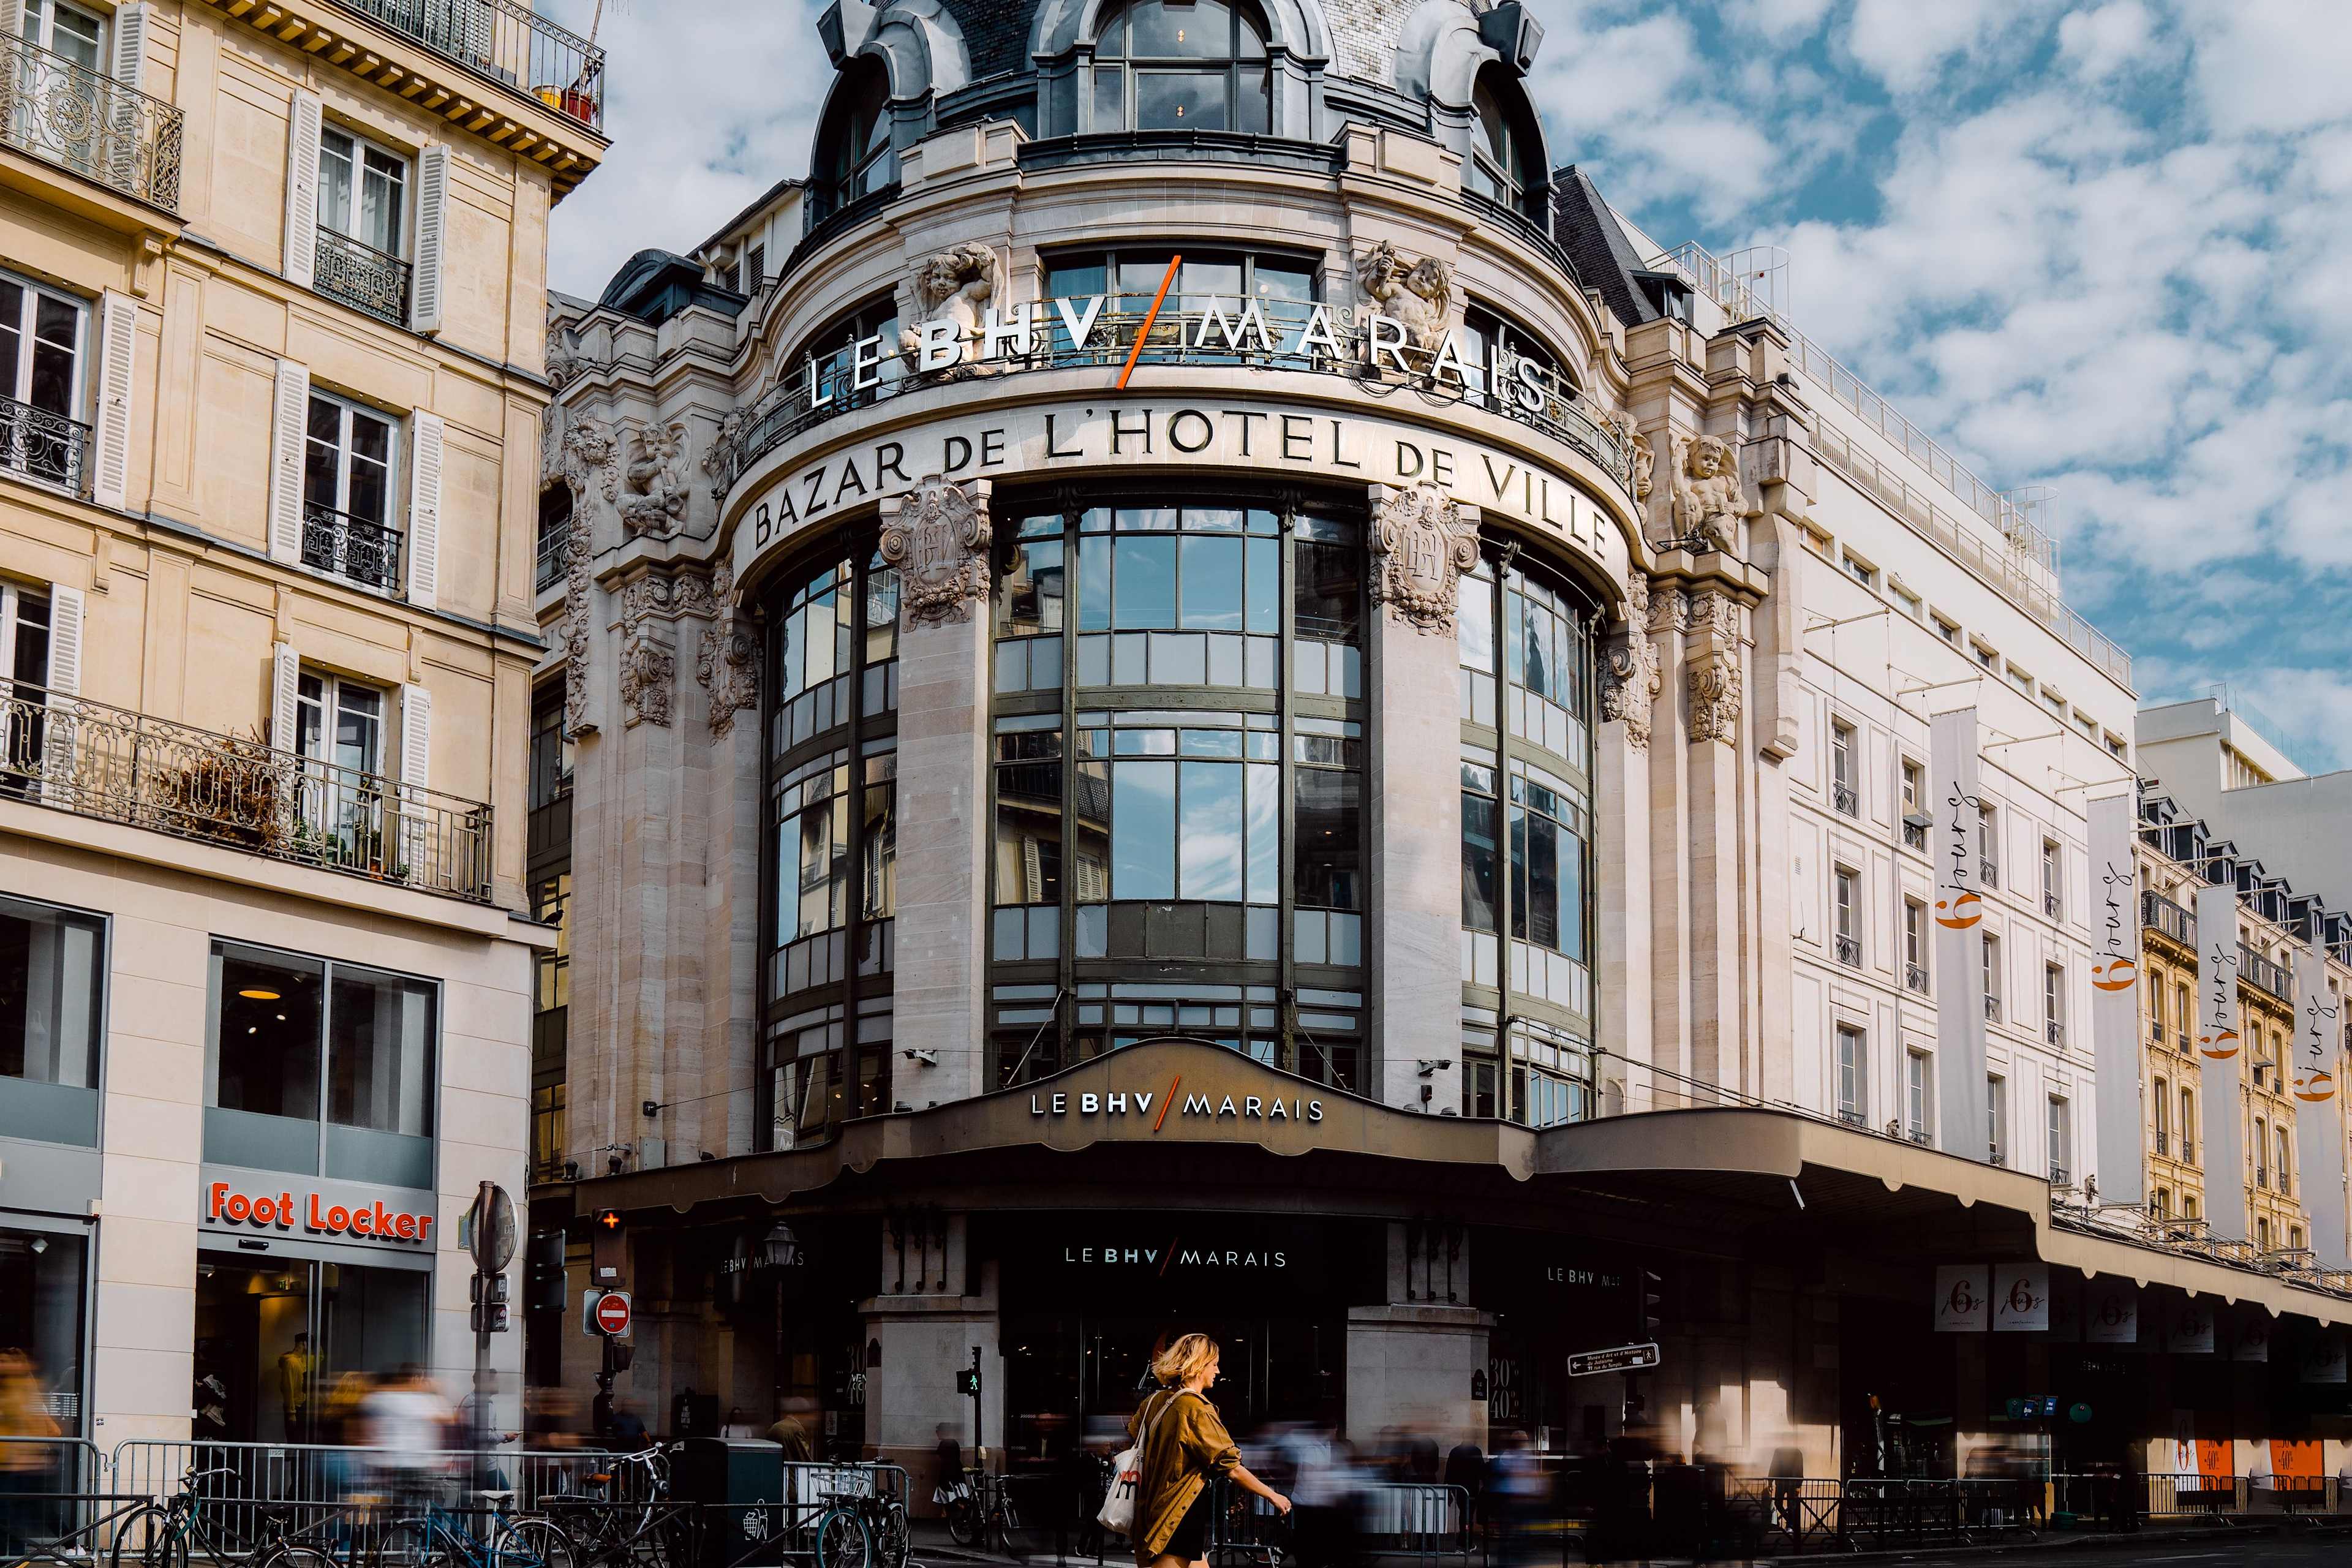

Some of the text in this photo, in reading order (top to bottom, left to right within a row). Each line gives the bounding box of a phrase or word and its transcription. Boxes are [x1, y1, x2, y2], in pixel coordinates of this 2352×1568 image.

[811, 334, 883, 409] LE
[755, 409, 1606, 559] BAZAR DE L'HOTEL DE VILLE
[1032, 1094, 1066, 1114] LE
[211, 1182, 433, 1241] Foot Locker
[1066, 1248, 1092, 1262] LE
[1548, 1267, 1563, 1281] LE
